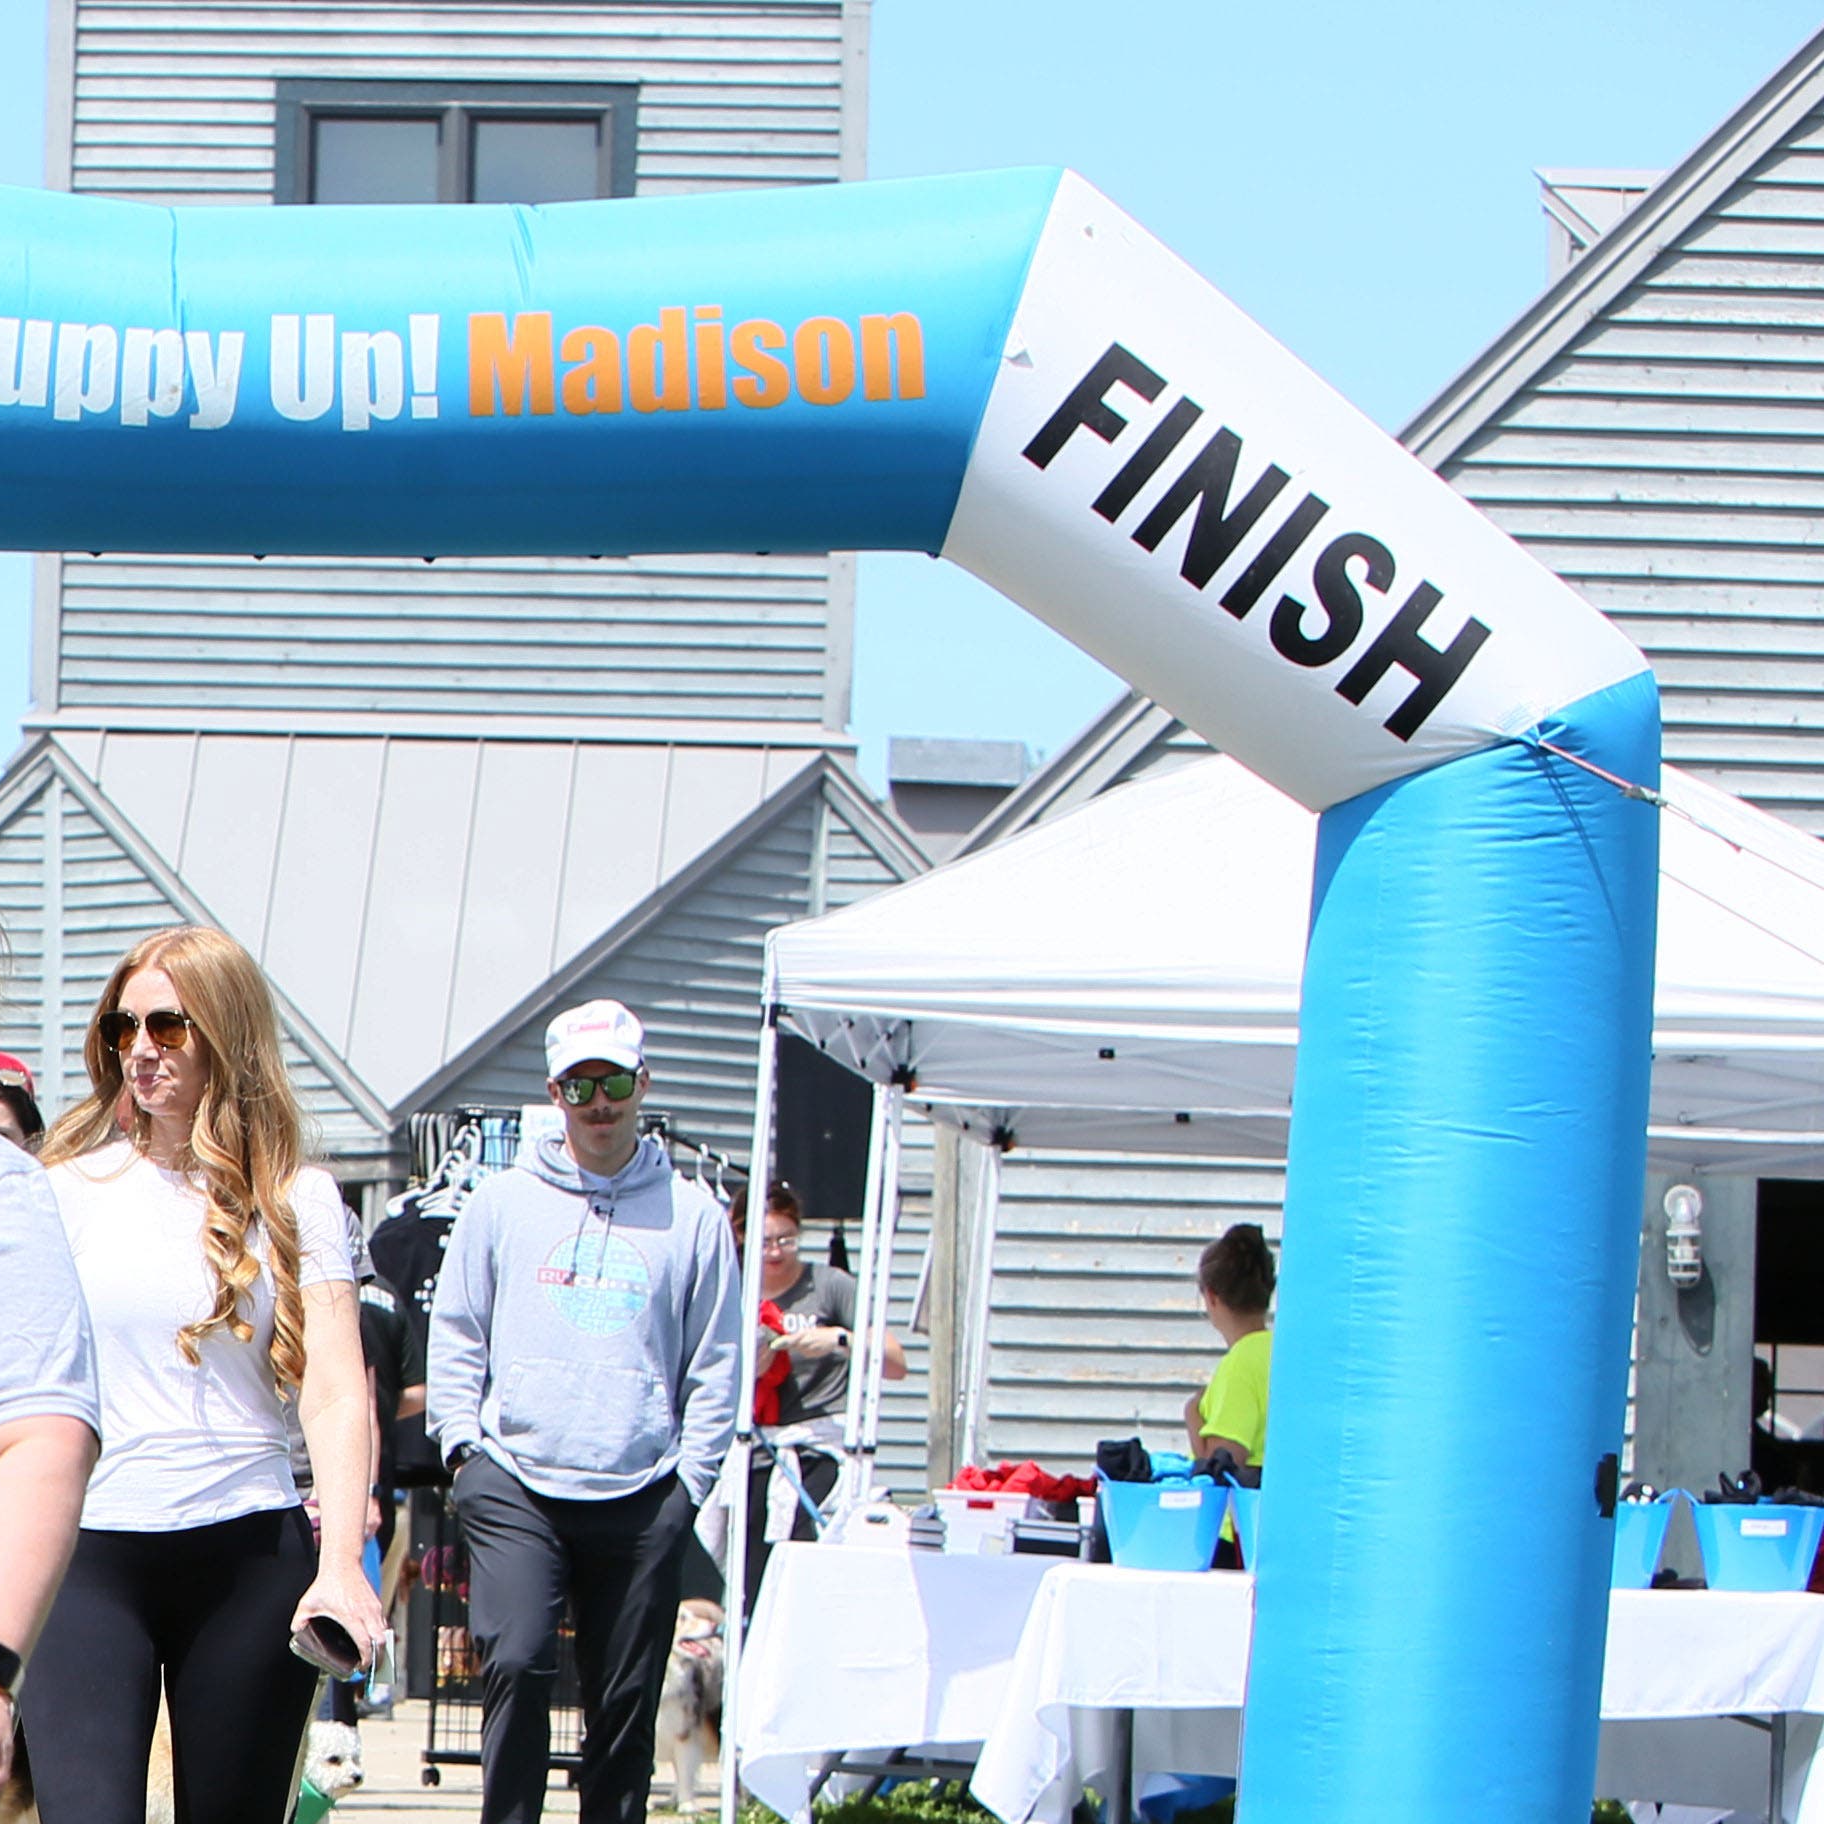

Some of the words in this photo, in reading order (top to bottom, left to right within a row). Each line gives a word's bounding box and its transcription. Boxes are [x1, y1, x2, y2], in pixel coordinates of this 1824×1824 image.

[269, 313, 441, 432] Up!
[466, 304, 928, 418] Madison
[1019, 340, 1493, 744] FINISH
